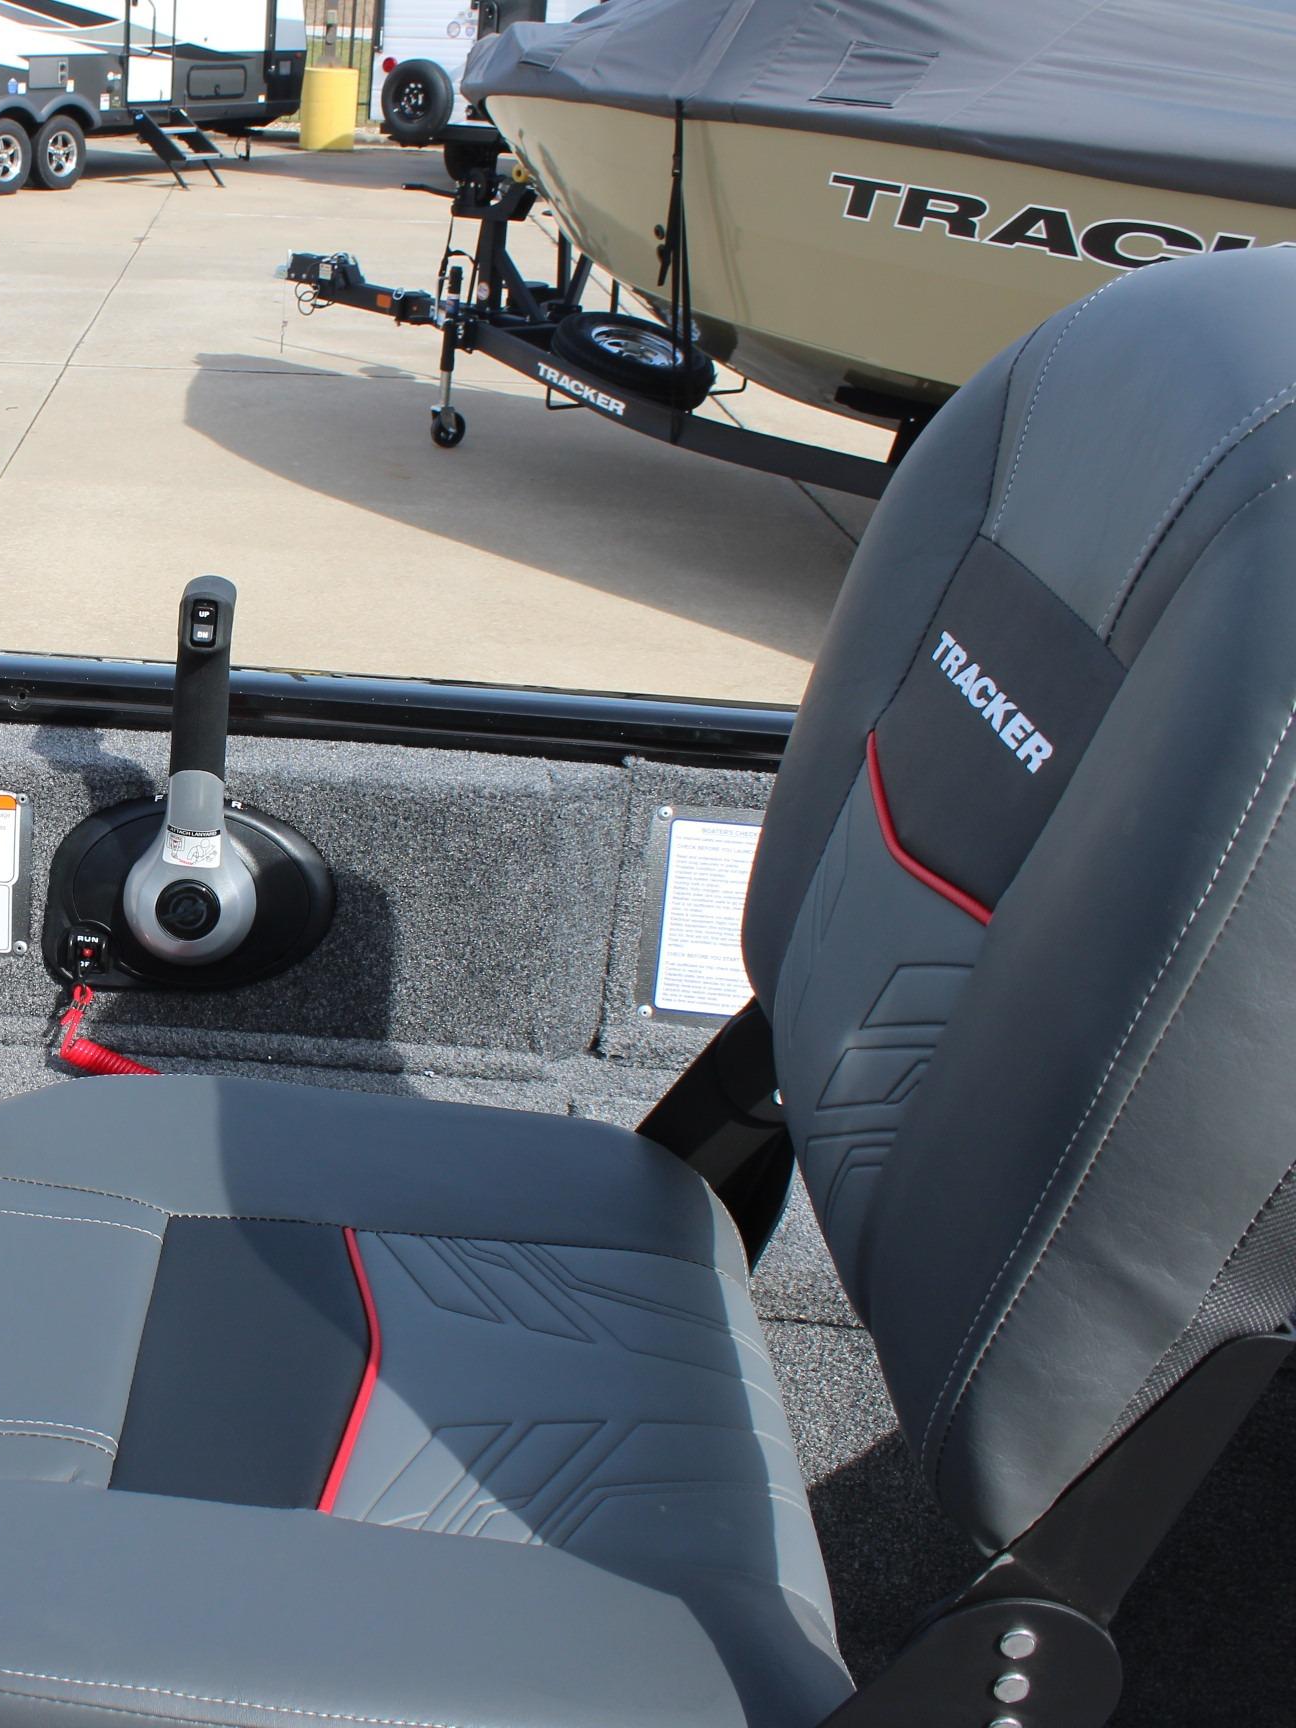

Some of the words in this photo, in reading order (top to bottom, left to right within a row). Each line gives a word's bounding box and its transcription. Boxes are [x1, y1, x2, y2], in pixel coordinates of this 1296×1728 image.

[537, 361, 626, 416] TRACKER
[198, 610, 211, 618] UP
[196, 630, 209, 639] DN
[932, 630, 1054, 775] TRACKER
[231, 800, 244, 810] R
[169, 826, 191, 836] ATTACH
[77, 935, 99, 943] RUN
